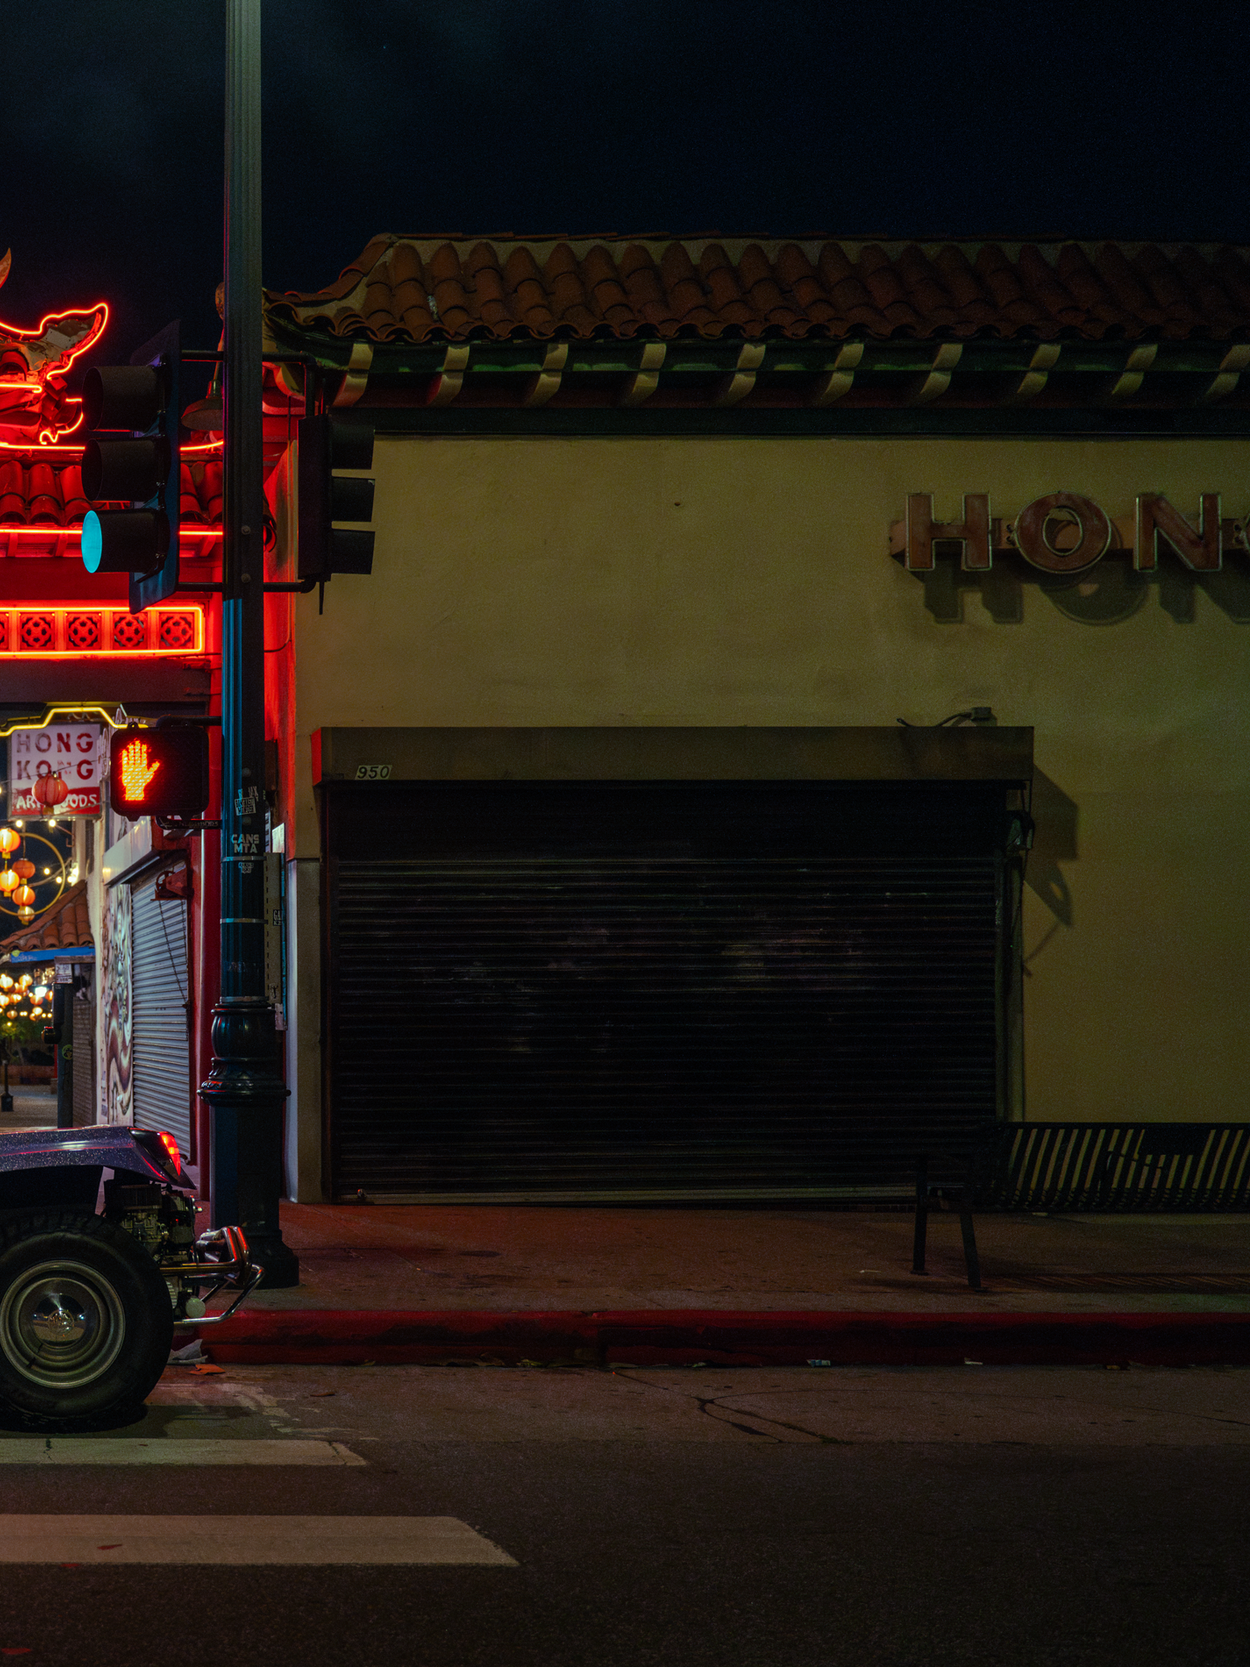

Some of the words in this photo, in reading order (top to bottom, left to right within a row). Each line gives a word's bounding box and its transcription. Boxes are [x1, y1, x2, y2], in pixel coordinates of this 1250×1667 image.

[906, 491, 1250, 573] HON
[16, 732, 94, 753] HONG
[357, 765, 390, 779] 950
[60, 793, 98, 809] OODS
[234, 843, 258, 854] MTA
